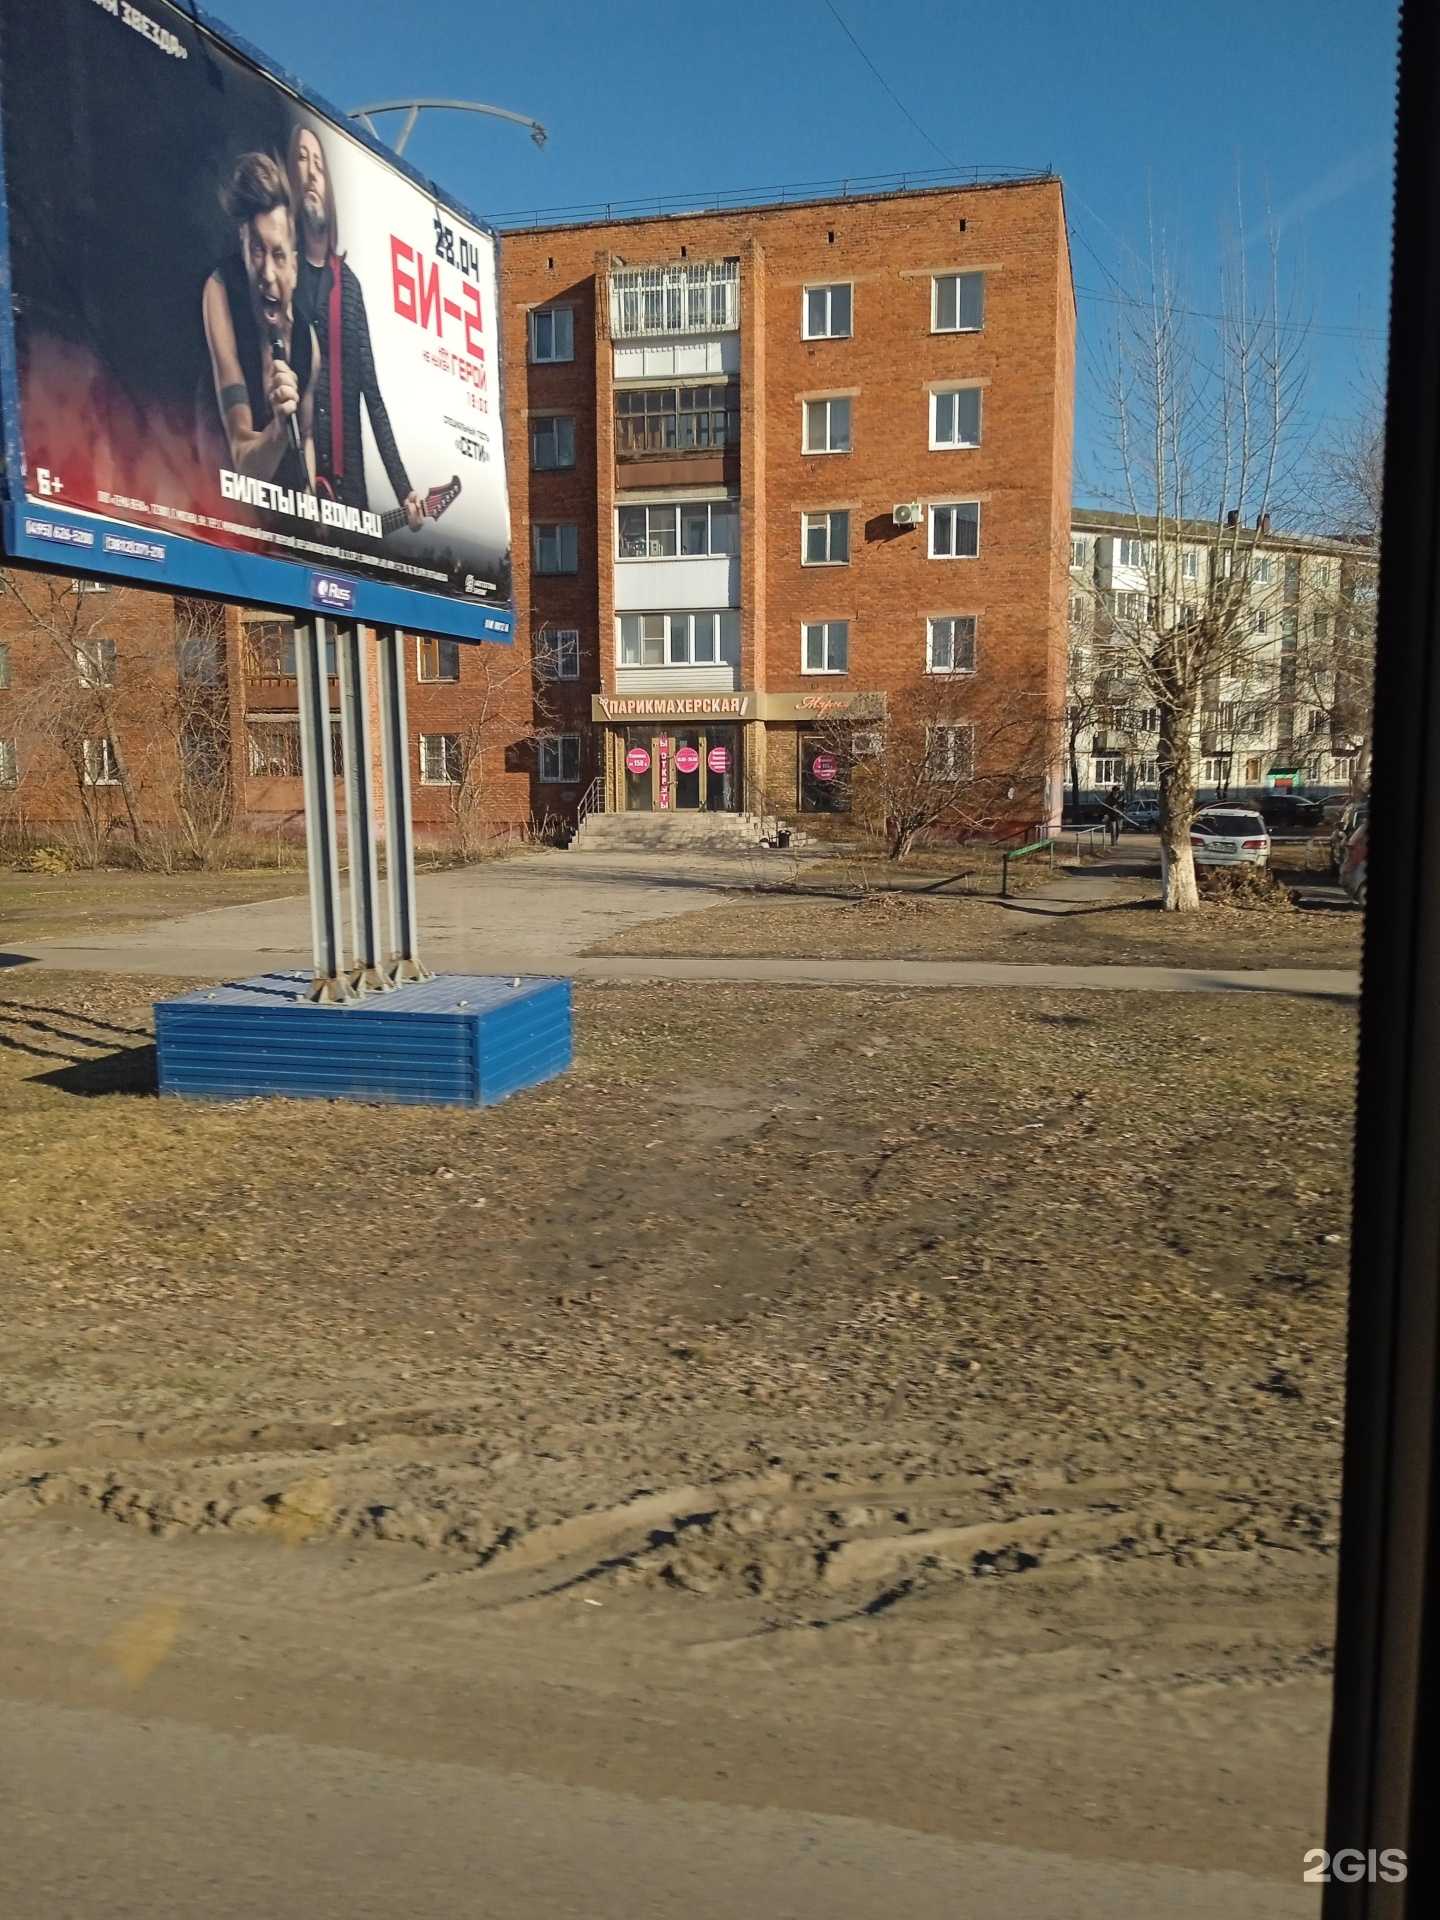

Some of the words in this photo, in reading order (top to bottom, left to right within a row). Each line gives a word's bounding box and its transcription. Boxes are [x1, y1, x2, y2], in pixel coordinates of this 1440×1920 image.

[434, 218, 480, 283] 28.04
[390, 234, 485, 362] БИ-2
[36, 467, 64, 496] 6+
[219, 469, 296, 515] БИЛЕТЫ
[296, 492, 320, 522] НА
[609, 697, 740, 714] ПАРИКМАХЕРСКАЯ
